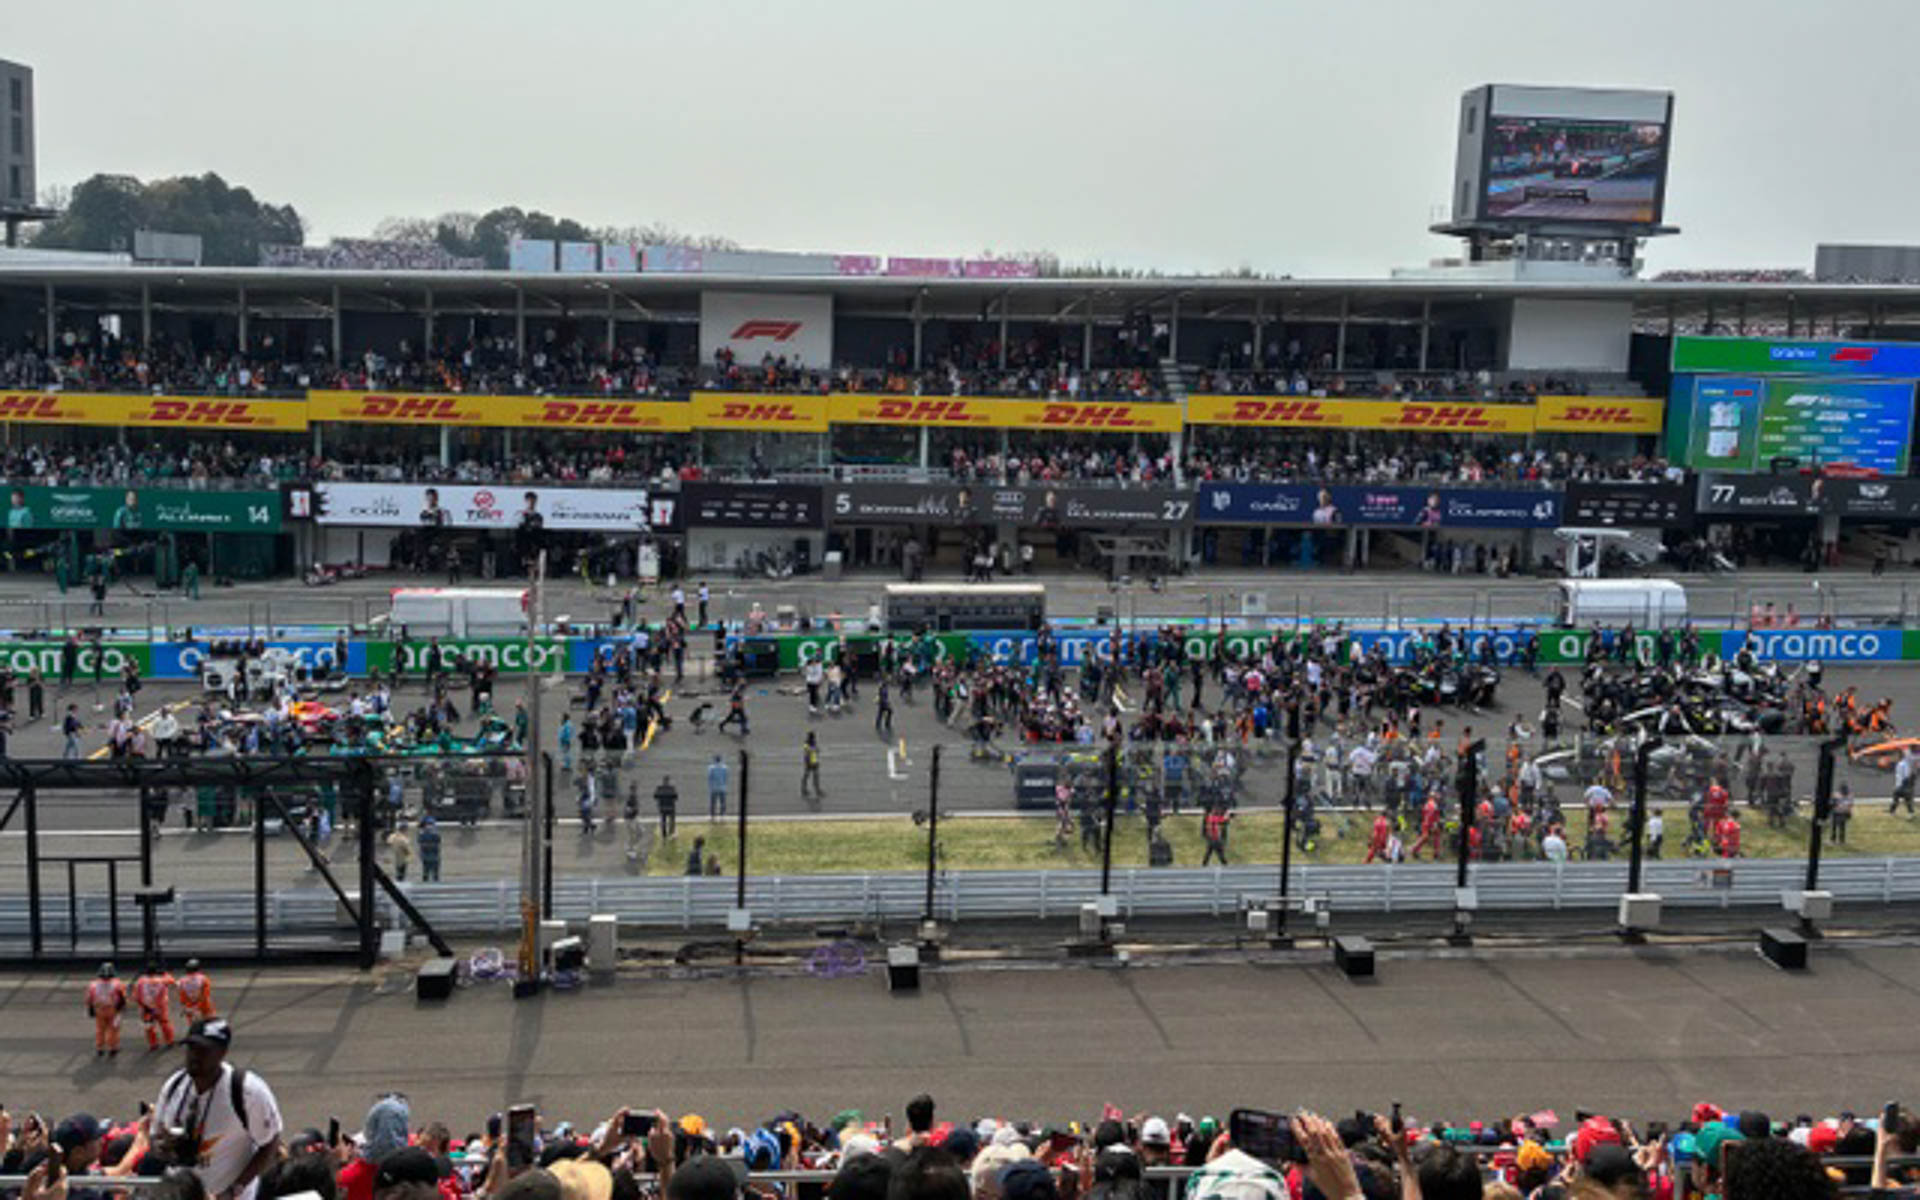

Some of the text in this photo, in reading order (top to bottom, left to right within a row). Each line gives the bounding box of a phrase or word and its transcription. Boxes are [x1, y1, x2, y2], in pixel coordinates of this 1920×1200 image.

[731, 319, 802, 341] F1
[150, 402, 254, 423] DHL
[362, 396, 462, 418] DHL
[542, 401, 641, 424] DHL
[722, 404, 796, 421] DHL
[876, 399, 971, 421] DHL
[1042, 404, 1135, 426] DHL
[1232, 402, 1324, 421] DHL
[1401, 405, 1489, 426] DHL
[1563, 407, 1634, 423] DHL
[836, 493, 852, 513] 5
[1711, 485, 1735, 502] 77
[248, 506, 270, 523] 14
[1162, 502, 1189, 520] 27
